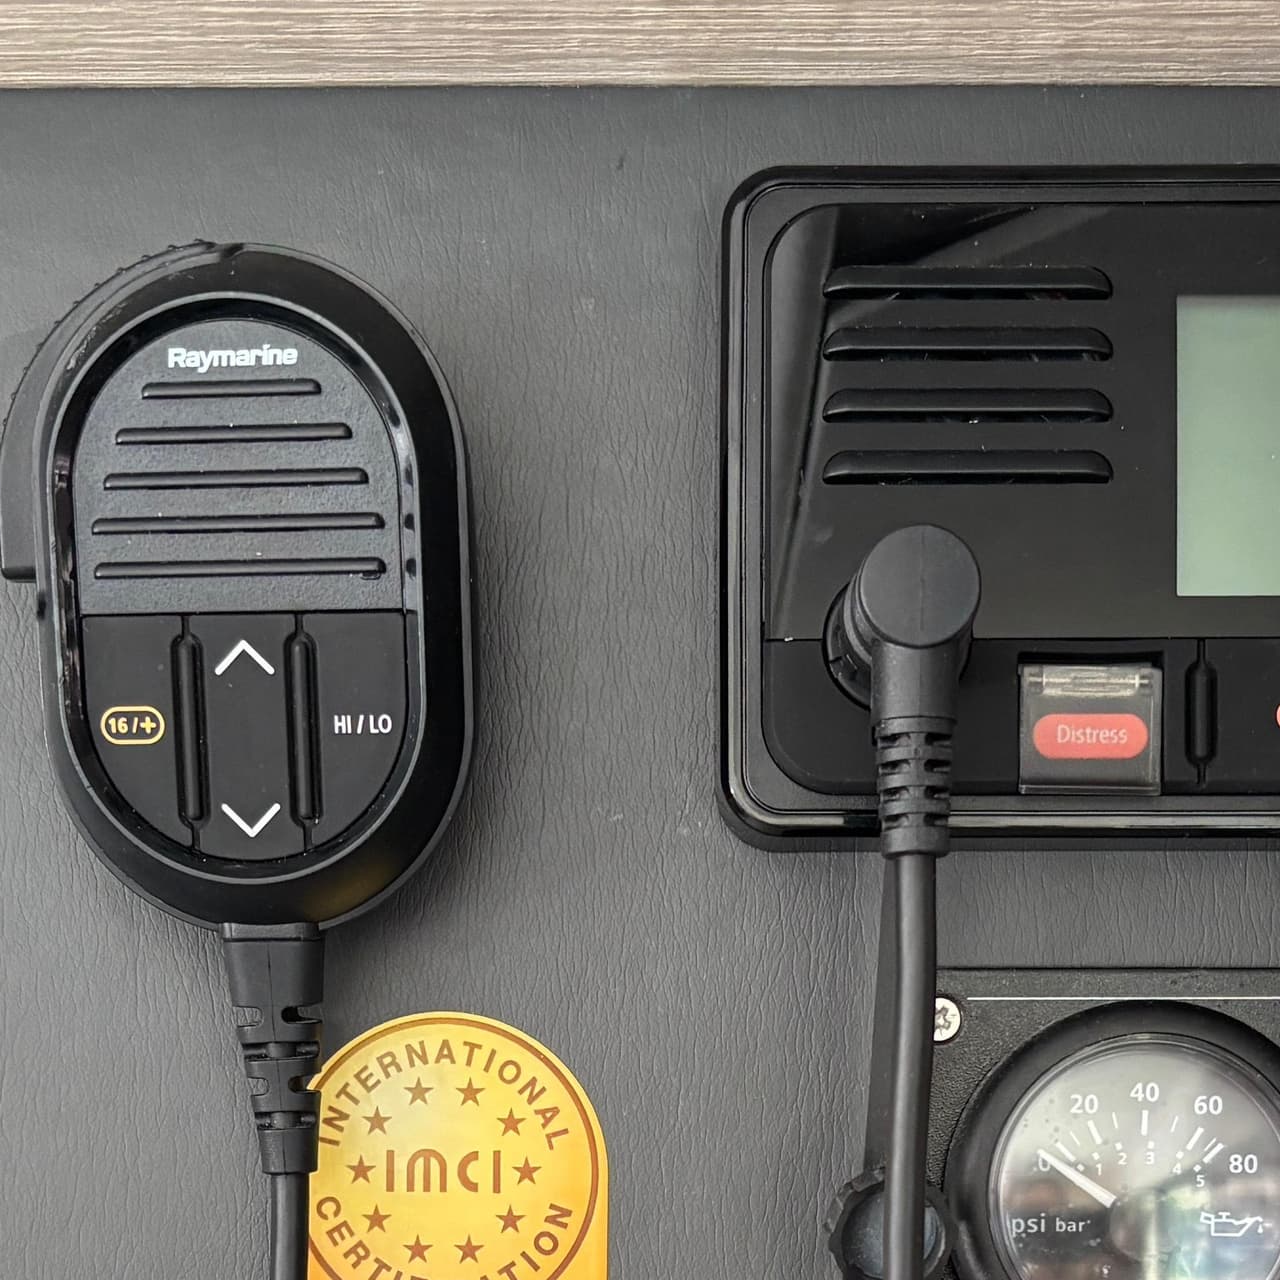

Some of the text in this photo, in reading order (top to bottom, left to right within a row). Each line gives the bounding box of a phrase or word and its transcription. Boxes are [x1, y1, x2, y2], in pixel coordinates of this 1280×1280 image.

[168, 344, 298, 373] Raymarine
[1056, 724, 1128, 744] Distress
[319, 1039, 570, 1151] INTERNATIONAL
[1130, 1083, 1159, 1102] 40
[1070, 1094, 1098, 1114] 20
[1194, 1096, 1222, 1115] 60
[385, 1148, 502, 1194] IMCI
[1230, 1154, 1257, 1173] 80
[1011, 1213, 1086, 1237] psi bar
